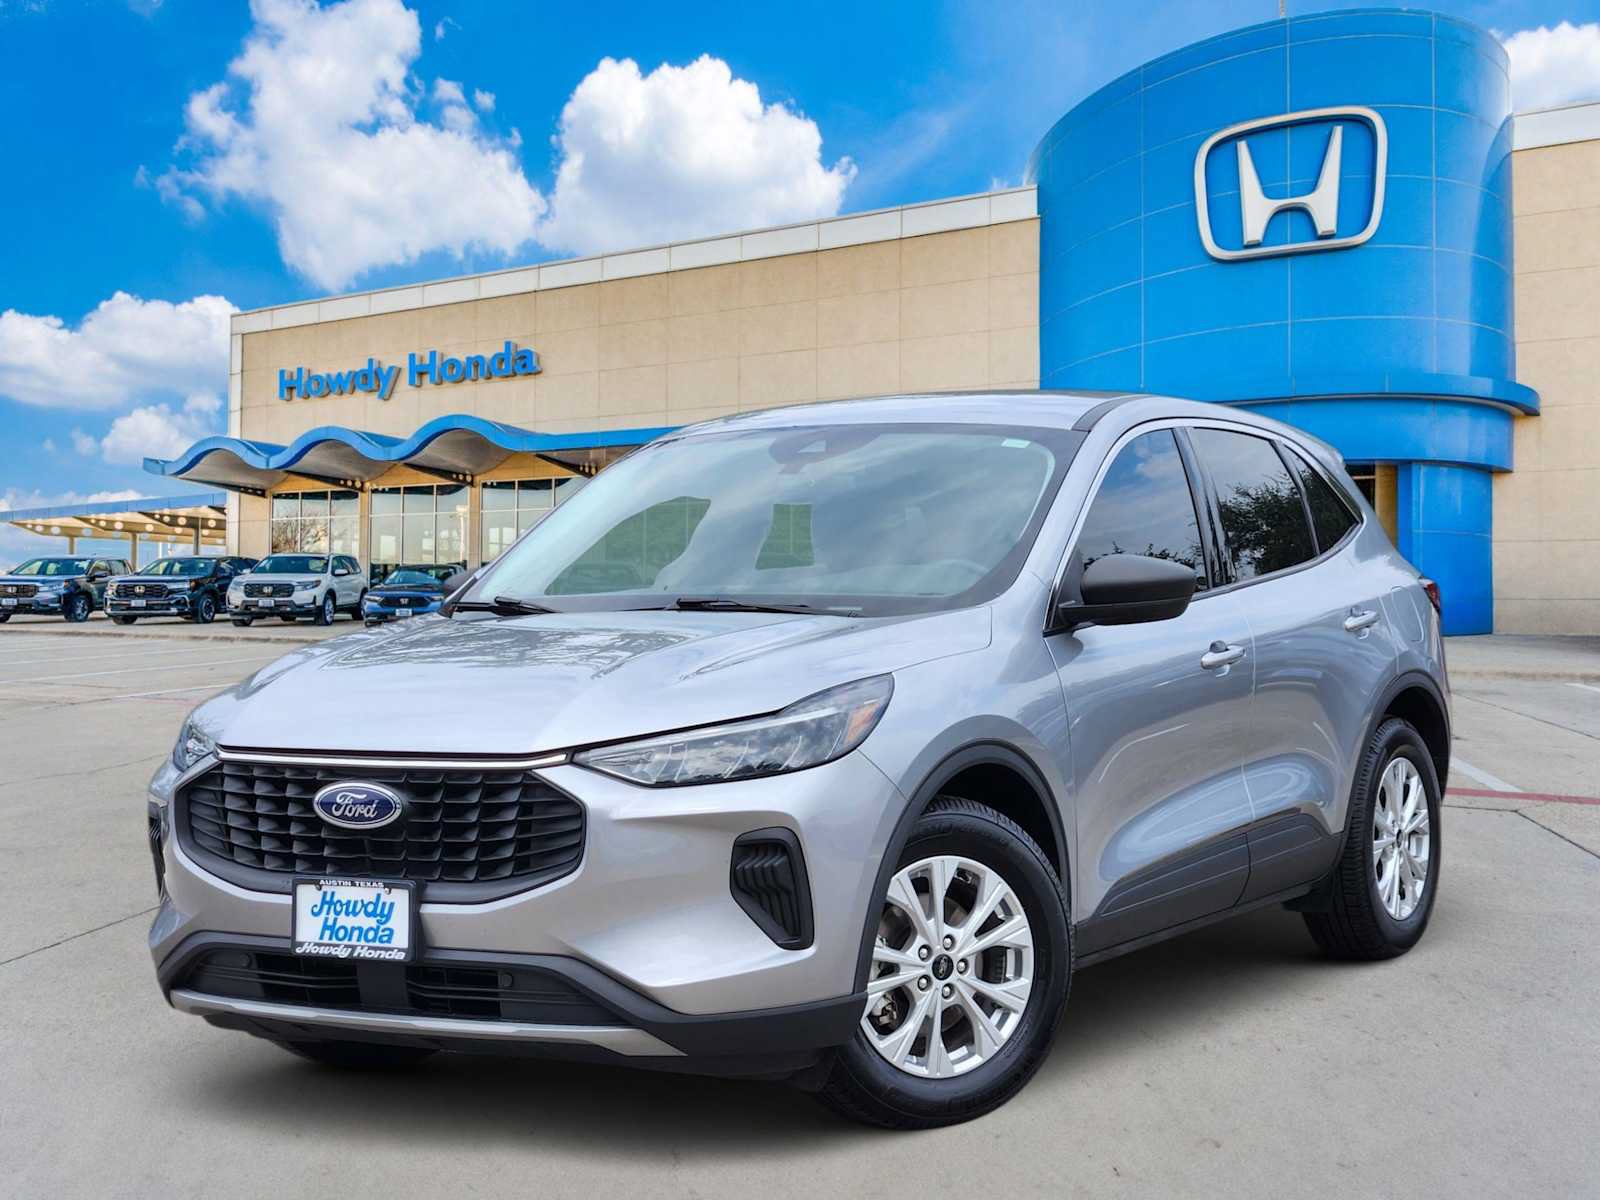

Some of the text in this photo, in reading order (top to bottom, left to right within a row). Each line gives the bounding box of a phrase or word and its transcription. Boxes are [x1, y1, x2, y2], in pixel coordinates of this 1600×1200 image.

[278, 340, 542, 401] Howdy Honda
[331, 791, 379, 819] Ford
[319, 879, 384, 888] AUSTIN TEXAS
[311, 890, 395, 924] Howdy
[319, 917, 394, 944] Honda
[296, 942, 406, 960] Howdy Honda
